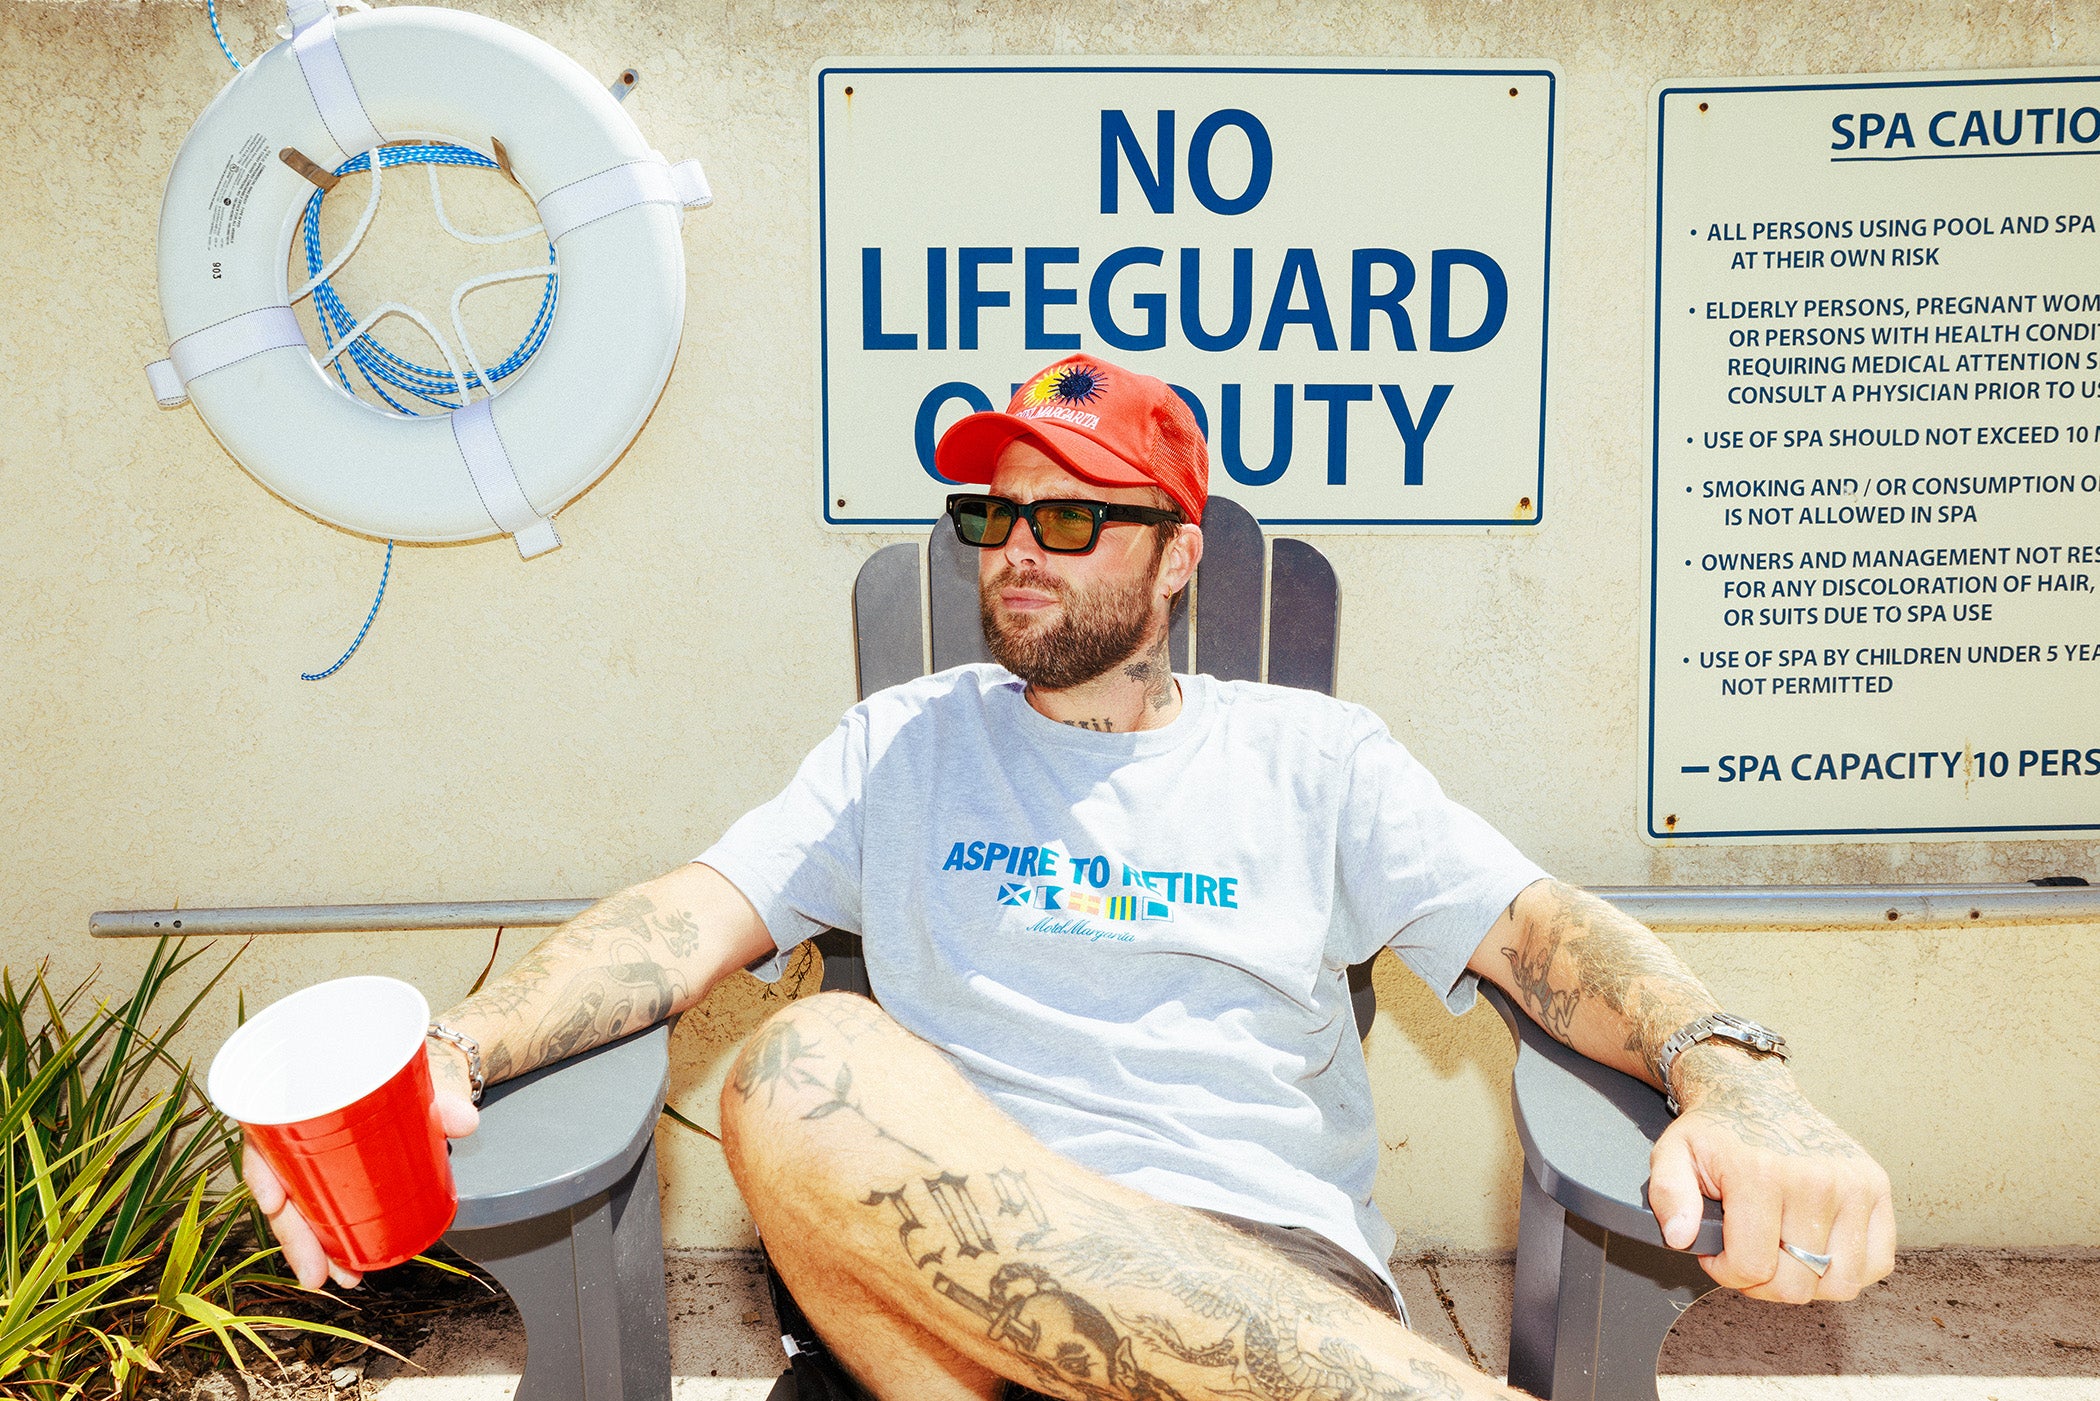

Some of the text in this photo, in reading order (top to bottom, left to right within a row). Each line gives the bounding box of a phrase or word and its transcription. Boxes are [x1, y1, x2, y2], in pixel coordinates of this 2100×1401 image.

[1830, 112, 1916, 151] SPA
[1101, 108, 1273, 215] NO
[1707, 214, 2096, 242] ALL PERSONS USING POOL AND SPA
[1730, 247, 1940, 270] AT THEIR OWN RISK
[862, 246, 1508, 352] LIFEGUARD
[1706, 300, 1799, 320] ELDERLY
[1804, 297, 1910, 319] PERSONS,
[1916, 295, 2038, 316] PREGNANT
[1729, 329, 1760, 348] OR
[1765, 327, 1866, 347] PERSONS
[1871, 326, 1929, 345] WITH
[1935, 324, 2020, 344] HEALTH
[1728, 356, 1846, 378] REQUIRING
[1851, 354, 1950, 374] MEDICAL
[1955, 352, 2080, 372] ATTENTION
[1727, 380, 2100, 405] CONSULT A PHYSICIAN PRIOR TO U
[1034, 405, 1101, 431] MARGARITA
[1171, 383, 1454, 487] UTY
[1704, 431, 1744, 449] USE
[1749, 430, 1778, 449] OF
[1783, 429, 1824, 448] SPA
[1829, 428, 1920, 447] SHOULD
[1925, 427, 1972, 446] NOT
[1977, 425, 2059, 445] EXCEED
[2066, 426, 2089, 444] 10
[1702, 479, 1805, 499] SMOKING
[1810, 478, 1859, 496] AND
[1876, 478, 1907, 496] OR
[1912, 475, 2075, 496] CONSUMPTION
[2080, 474, 2100, 493] O
[1725, 505, 1978, 526] IS NOT ALLOWED IN SPA
[1701, 552, 1794, 572] OWNERS
[1799, 551, 1847, 569] AND
[1852, 547, 2011, 568] MANAGEMENT
[2016, 546, 2063, 565] NOT
[1724, 574, 2095, 599] FOR ANY DISCOLORATION OF HAIR,
[1723, 603, 1993, 627] OR SUITS DUE TO SPA USE
[1700, 650, 1739, 669] USE
[1744, 650, 1773, 668] OF
[1778, 649, 1818, 667] SPA
[1823, 648, 1850, 666] BY
[1855, 646, 1962, 666] CHILDREN
[1967, 645, 2041, 664] UNDER
[2046, 645, 2058, 662] 5
[1722, 676, 1893, 696] NOT PERMITTED
[1718, 754, 1782, 783] SPA
[1791, 751, 1963, 781] CAPACITY
[1973, 751, 2009, 778] 10
[942, 840, 1060, 878] ASPIRE
[1069, 854, 1111, 889] TO
[1064, 919, 1136, 943] Margarita
